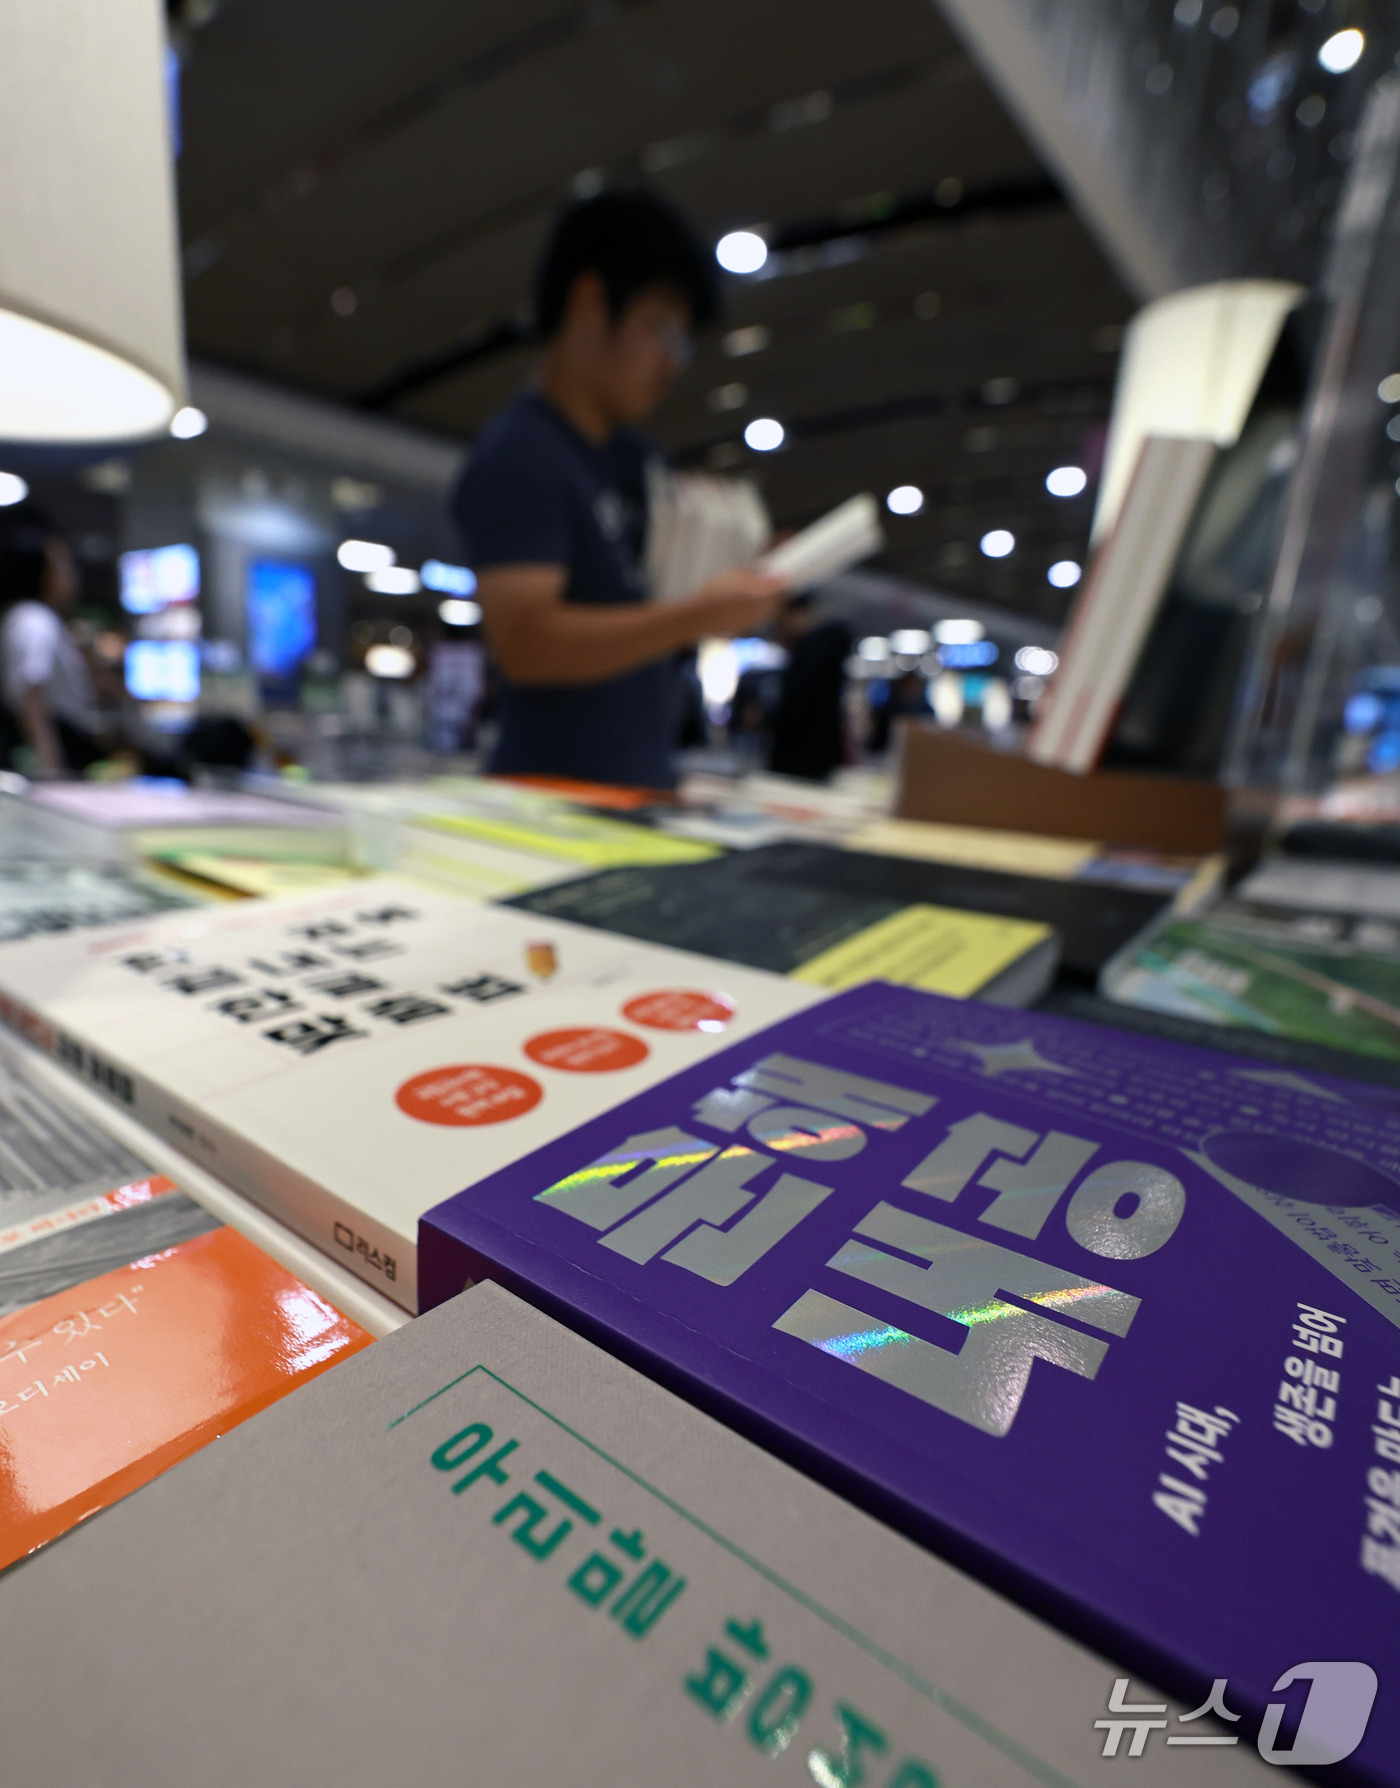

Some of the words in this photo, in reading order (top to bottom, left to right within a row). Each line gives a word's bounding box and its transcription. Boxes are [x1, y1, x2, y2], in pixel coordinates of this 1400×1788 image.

[533, 1052, 940, 1287] 문해
[772, 1112, 1187, 1438] 내공
[1292, 1302, 1347, 1360] 넘어
[1273, 1356, 1341, 1449] 생존을
[430, 1422, 687, 1641] 우리말
[1152, 1473, 1208, 1538] AI
